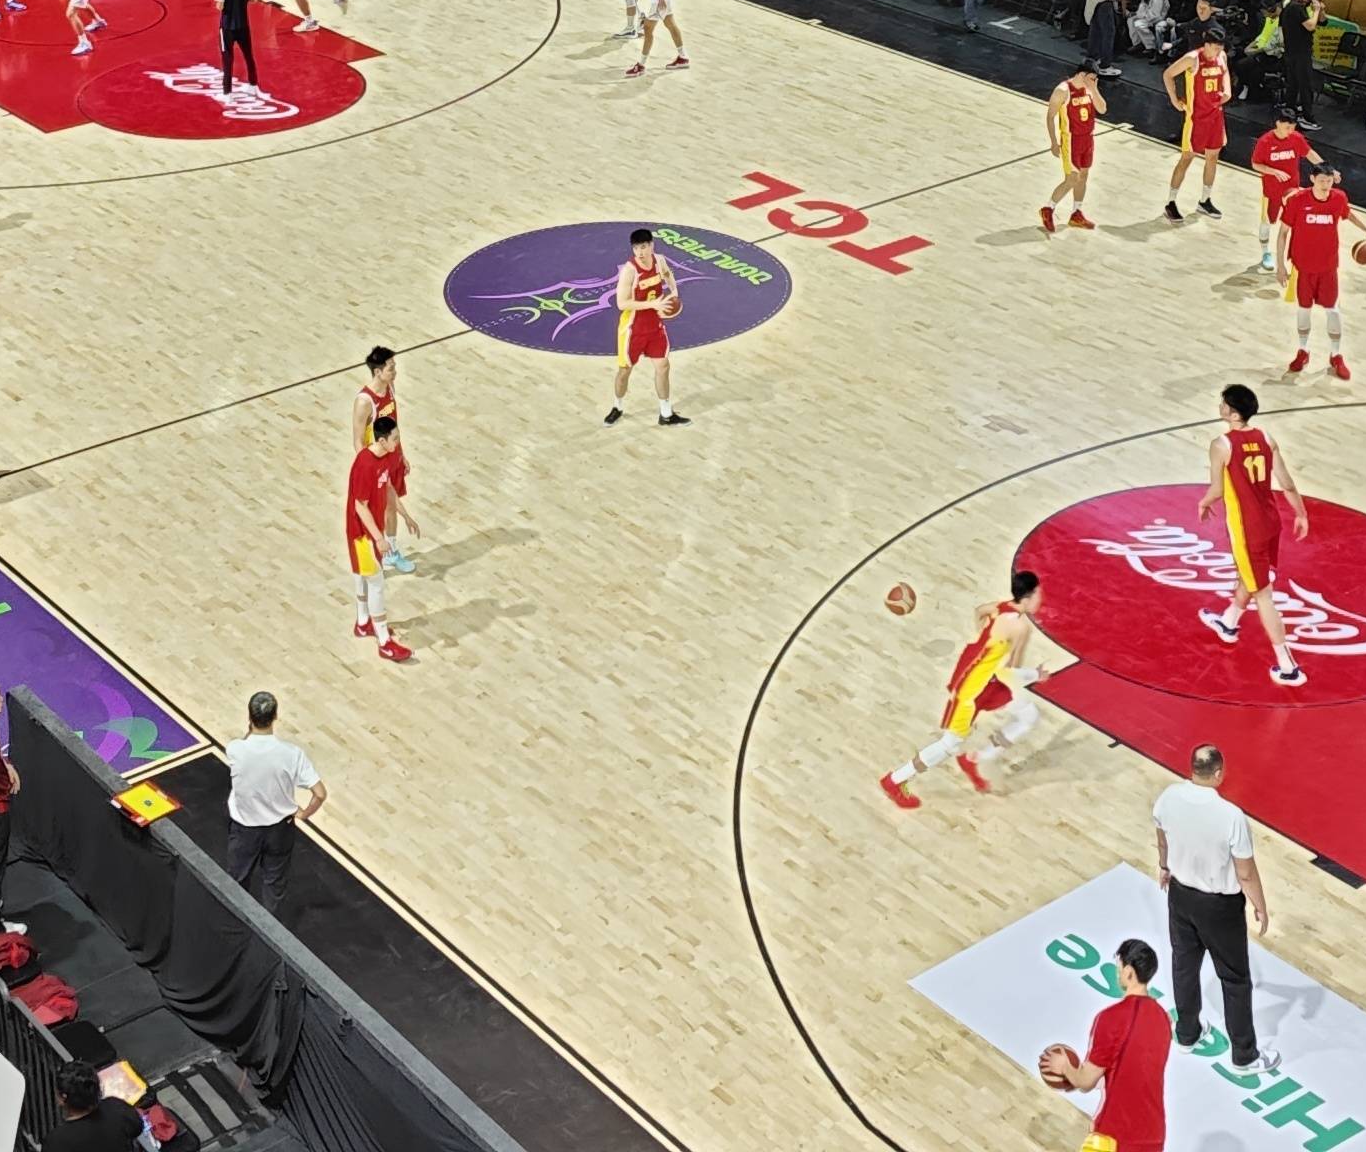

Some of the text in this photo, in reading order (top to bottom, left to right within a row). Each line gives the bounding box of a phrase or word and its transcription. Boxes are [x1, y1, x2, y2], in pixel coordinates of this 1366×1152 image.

[1079, 107, 1089, 122] 9
[725, 171, 936, 276] TCL
[1305, 213, 1333, 225] CHINA
[652, 228, 773, 286] QUALIFIERS
[1243, 455, 1266, 485] 11
